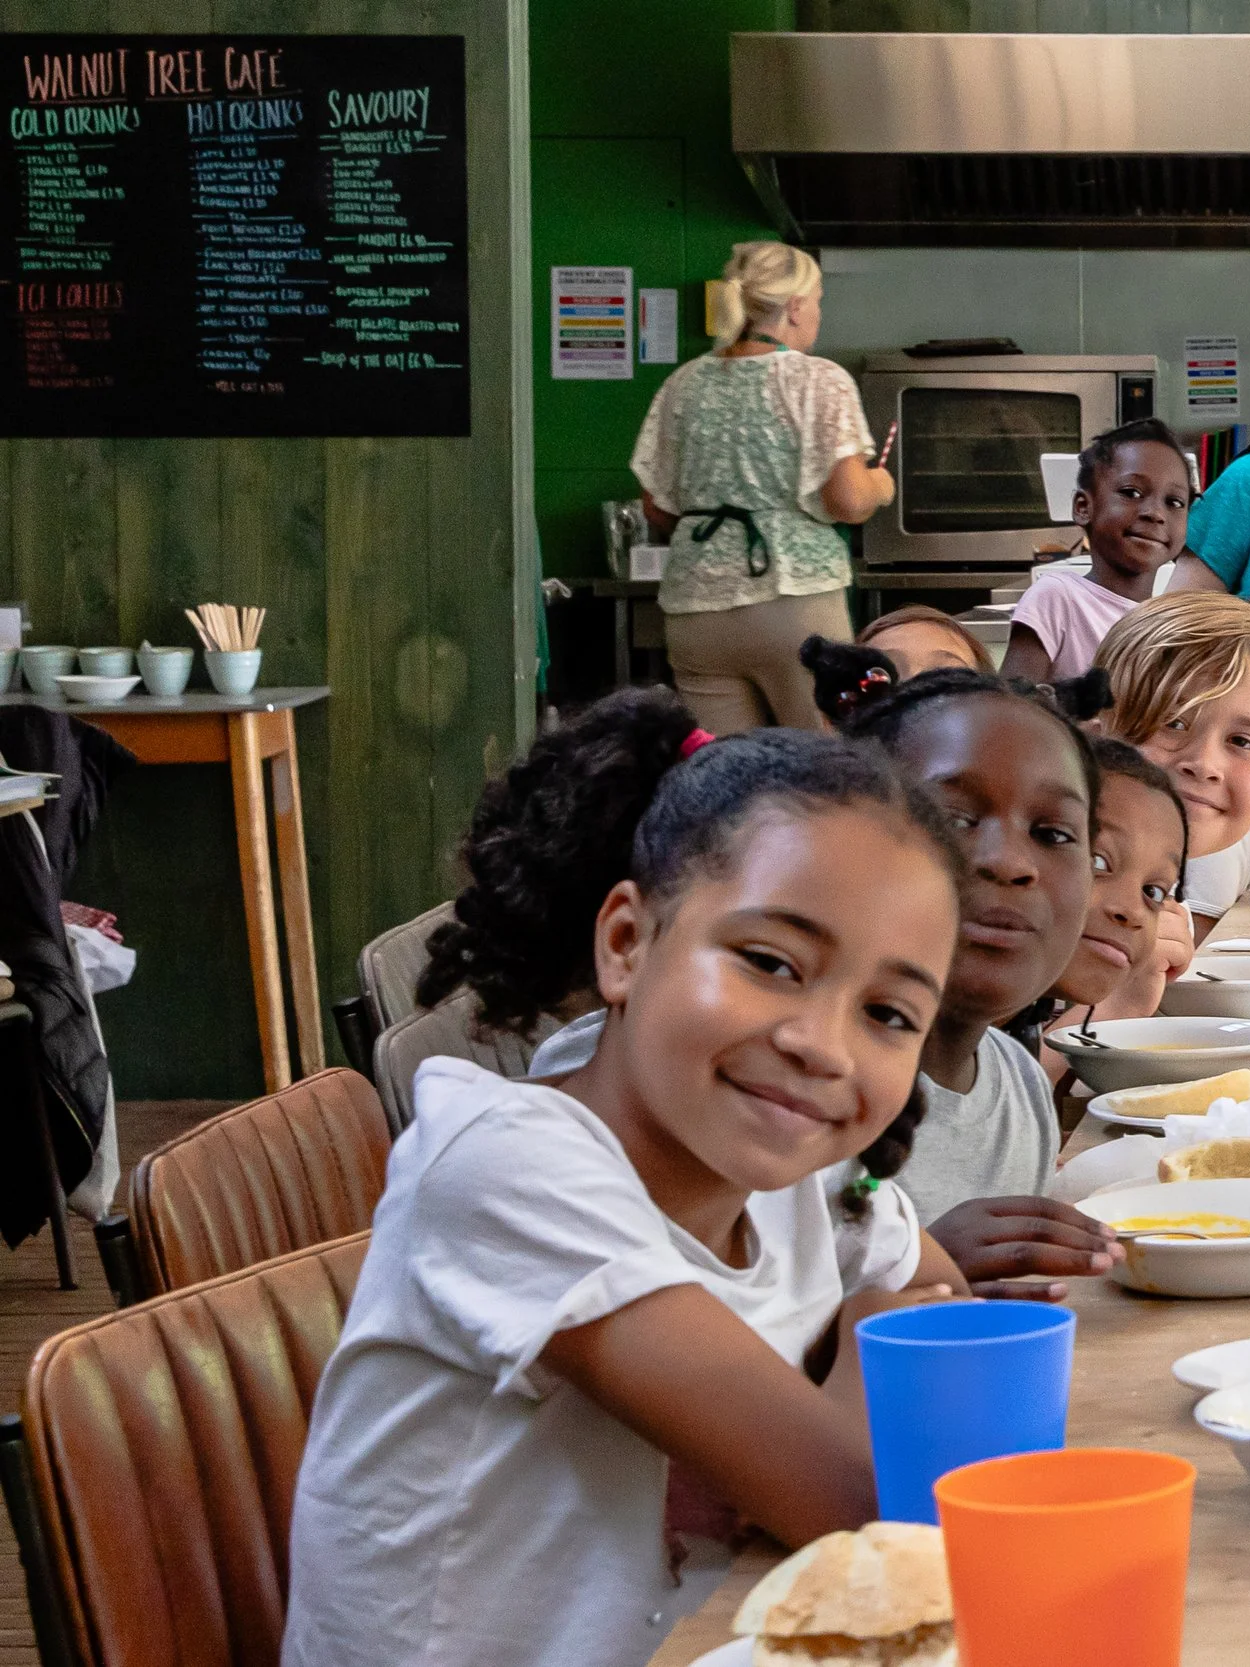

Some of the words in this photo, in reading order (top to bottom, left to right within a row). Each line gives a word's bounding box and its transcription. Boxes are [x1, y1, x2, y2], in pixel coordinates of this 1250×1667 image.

[23, 48, 130, 101] WALNUT
[145, 49, 213, 97] TREE
[10, 106, 59, 140] COLD
[64, 104, 141, 135] DRINKS
[187, 99, 225, 134] HOT
[228, 99, 304, 131] DRINKS
[328, 85, 430, 129] SAVOURY
